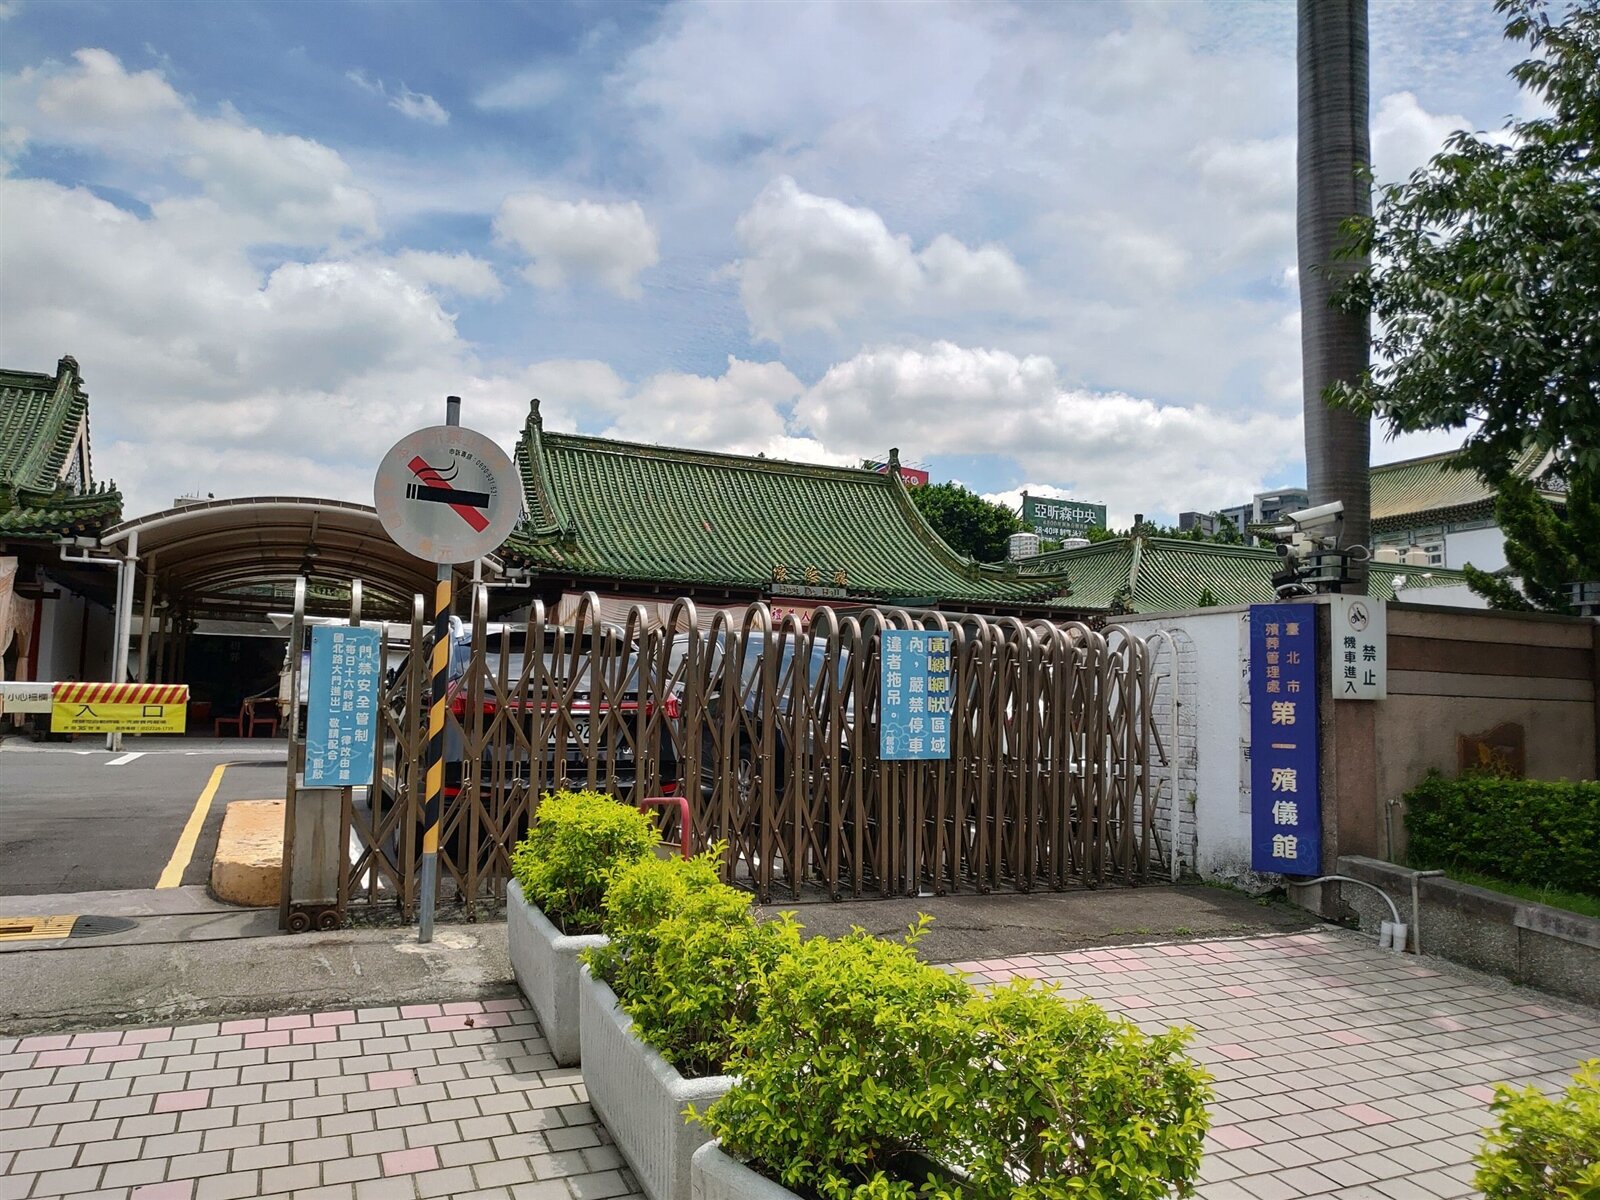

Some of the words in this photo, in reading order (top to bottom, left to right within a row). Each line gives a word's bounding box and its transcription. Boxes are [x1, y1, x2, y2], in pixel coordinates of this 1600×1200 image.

[1034, 503, 1097, 524] 亞昕森中央
[1265, 623, 1280, 693] 殯葬管理處
[1285, 622, 1300, 693] 臺北市
[1343, 636, 1357, 694] 機車進入
[1362, 644, 1376, 686] 禁止
[354, 645, 372, 743] 門禁安全管制
[930, 637, 946, 754] 黃線網狀區域
[1271, 700, 1298, 860] 第一殯儀館
